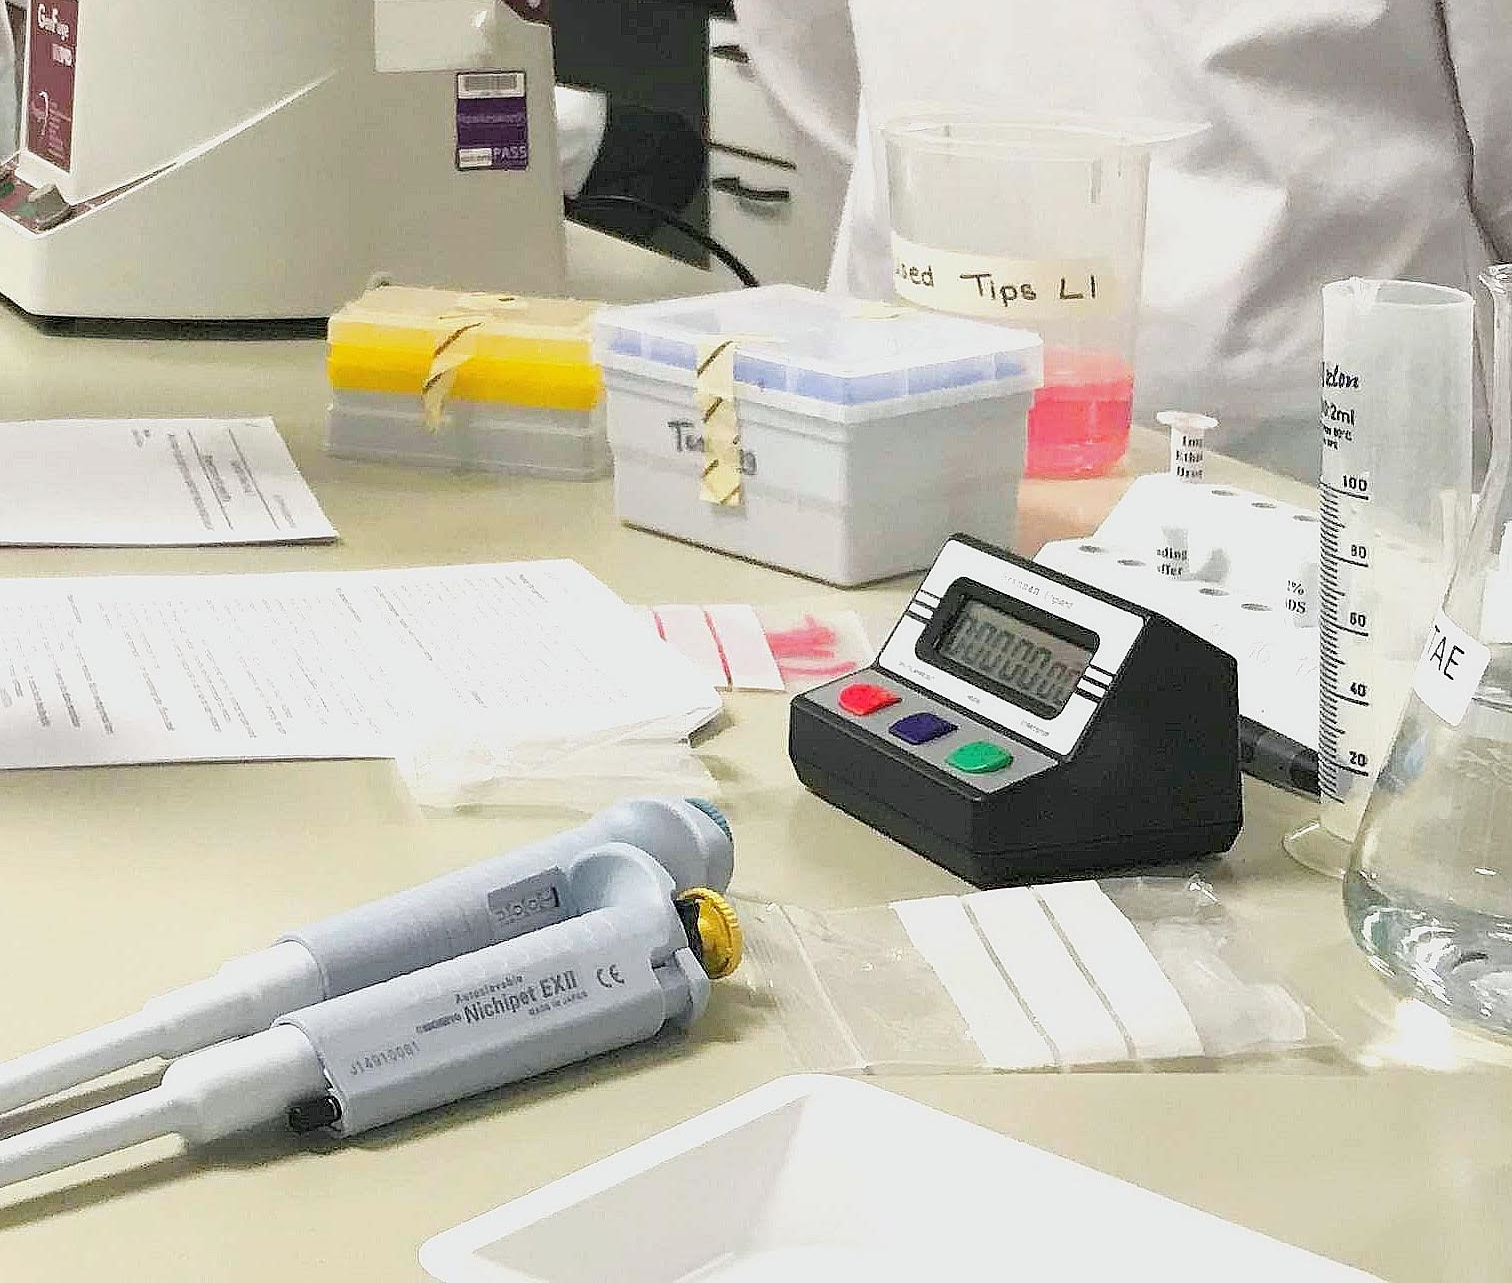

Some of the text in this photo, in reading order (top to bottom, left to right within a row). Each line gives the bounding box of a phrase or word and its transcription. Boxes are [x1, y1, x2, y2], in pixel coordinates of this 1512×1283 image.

[493, 146, 526, 159] PASS
[895, 263, 935, 288] sed
[959, 273, 1037, 308] Tips
[1342, 475, 1368, 492] 100
[1350, 544, 1367, 559] 80
[1349, 612, 1366, 628] 60
[1427, 624, 1465, 681] TAE
[1350, 682, 1367, 698] 40
[1349, 750, 1367, 767] 20
[462, 985, 537, 1024] Nichipet
